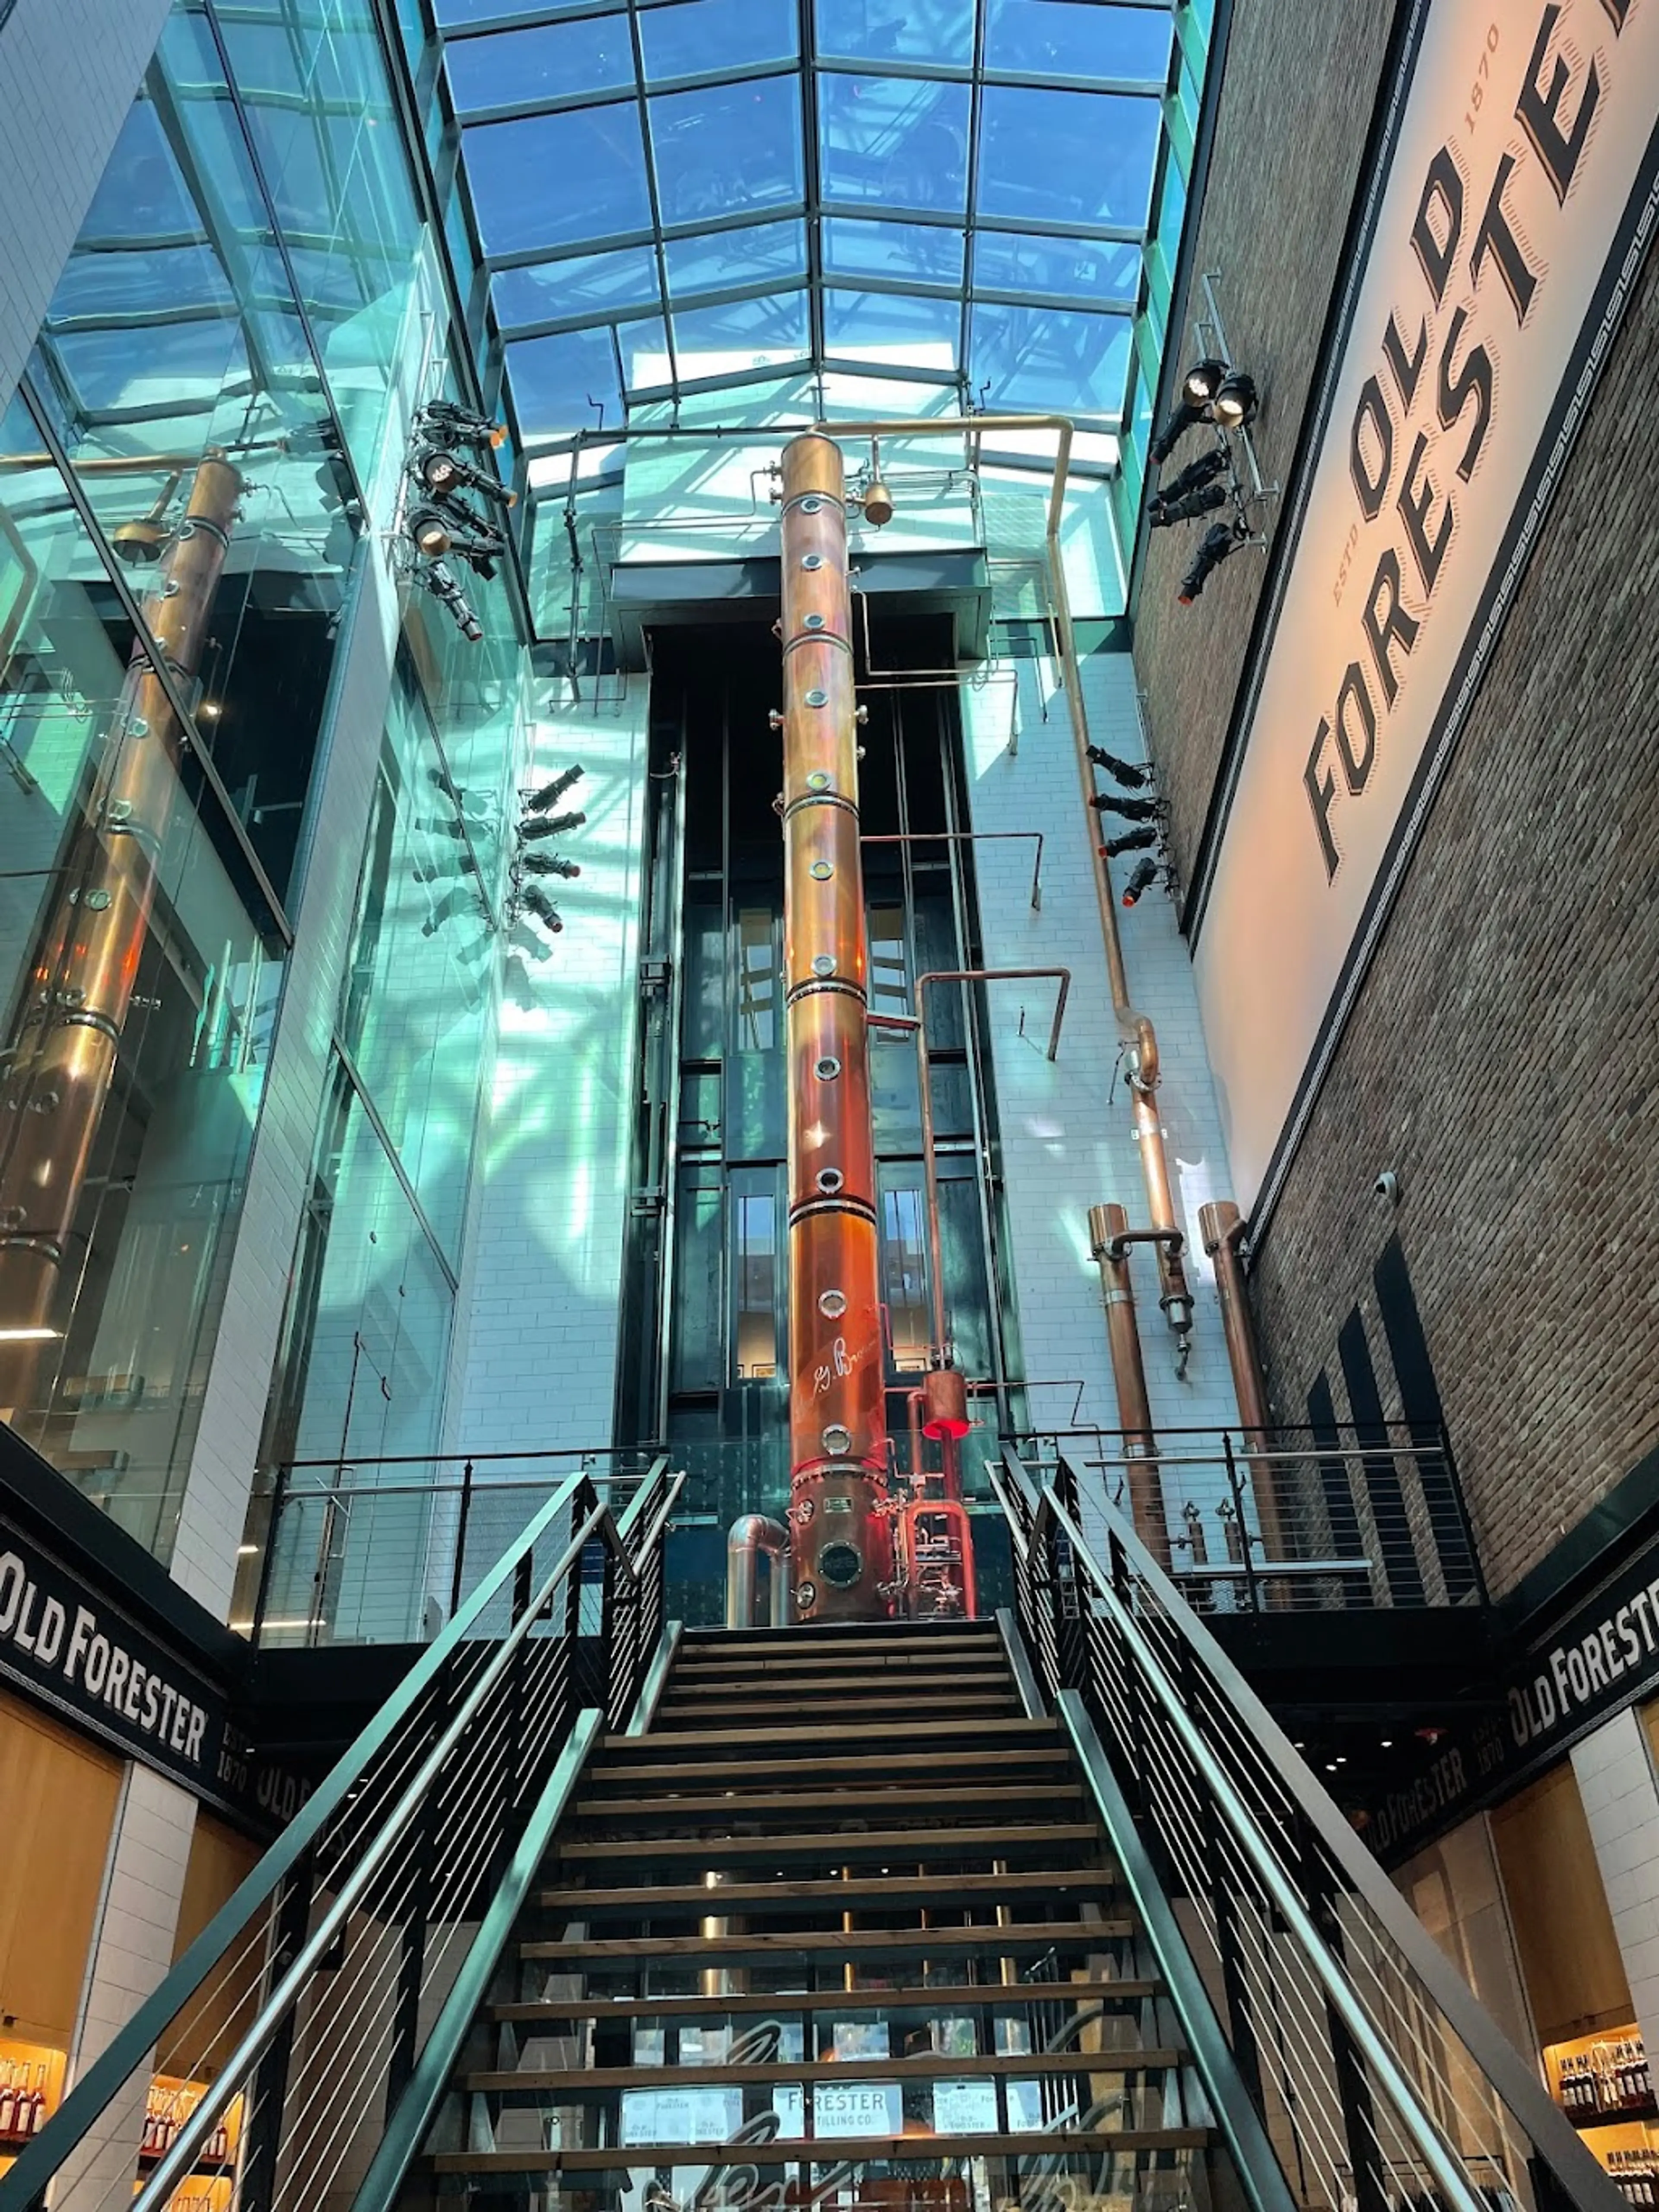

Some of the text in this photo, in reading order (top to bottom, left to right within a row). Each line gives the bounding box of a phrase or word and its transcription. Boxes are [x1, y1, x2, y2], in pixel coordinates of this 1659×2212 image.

[1465, 22, 1499, 136] 1870
[1350, 144, 1465, 523] OLD
[1303, 0, 1631, 888] FORESTE
[1333, 523, 1358, 608] ESTD
[0, 1550, 207, 1763] OLD FORESTER
[1507, 1675, 1555, 1747] OLD
[216, 1750, 247, 1792] 1870
[257, 1762, 296, 1822] OLD
[788, 2091, 884, 2111] FRESTER
